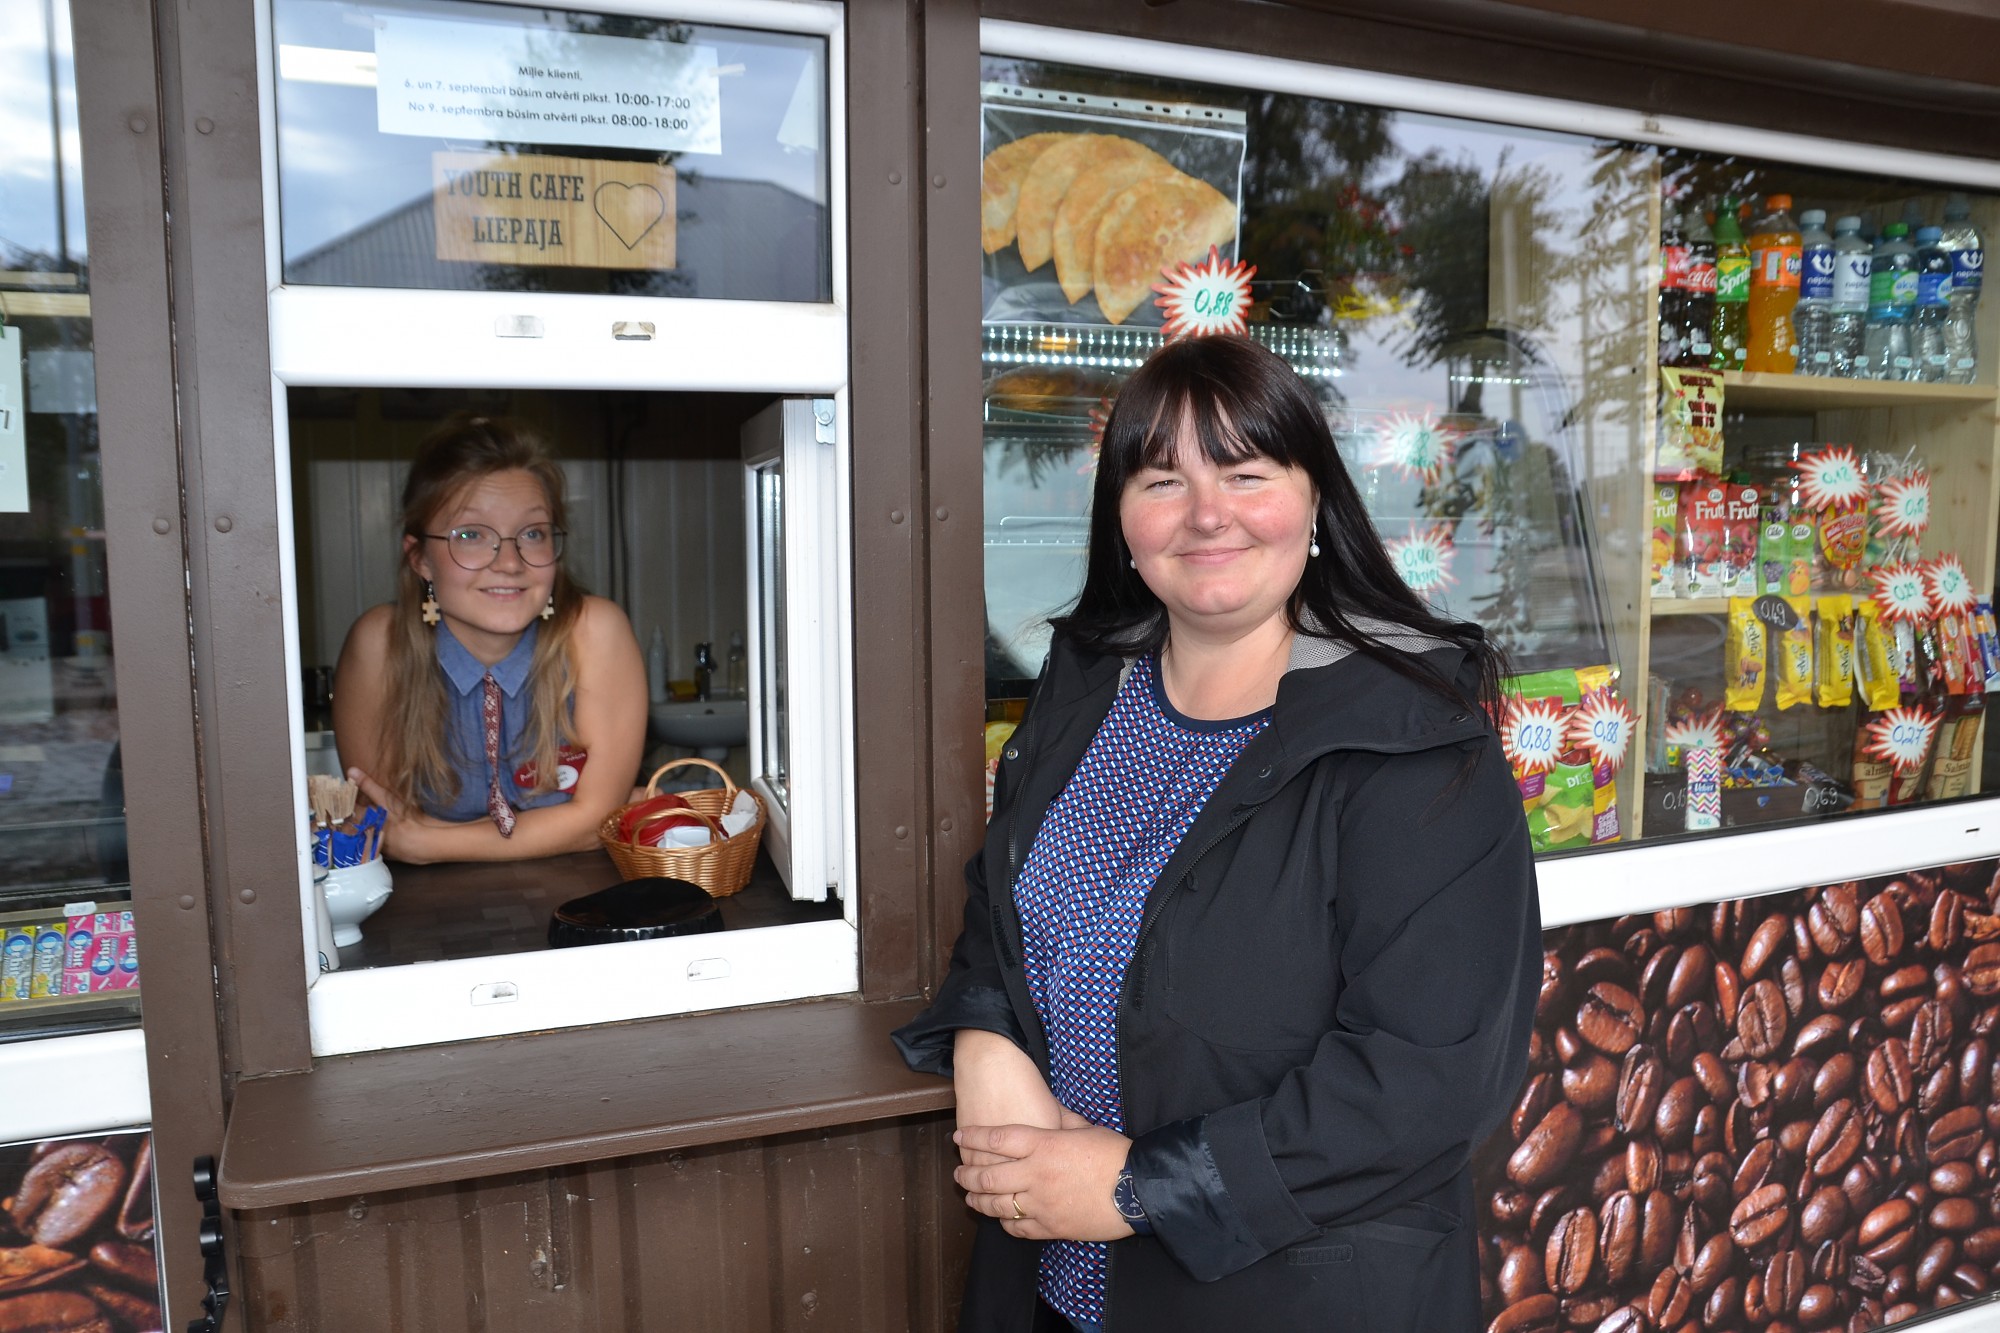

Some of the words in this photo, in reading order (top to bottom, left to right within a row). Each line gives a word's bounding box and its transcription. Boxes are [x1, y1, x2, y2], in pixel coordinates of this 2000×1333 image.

[547, 67, 583, 81] klienti,
[418, 81, 432, 90] un
[436, 80, 445, 91] 7.
[509, 86, 543, 98] būsim
[546, 89, 580, 101] atvērti
[582, 92, 611, 104] plkst.
[615, 92, 691, 109] 10:00-17:00
[408, 101, 425, 112] No
[441, 104, 504, 118] septembra
[506, 108, 540, 120] būsim
[543, 111, 578, 123] atvērti
[580, 115, 608, 126] plkst.
[611, 114, 688, 130] 08:00-18:00
[444, 169, 522, 199] YOUTH
[530, 173, 584, 202] CAFE
[472, 215, 562, 251] LIEPAJA
[1193, 288, 1235, 317] 0,88
[1520, 724, 1552, 752] 0,88
[1594, 720, 1619, 744] 0,88
